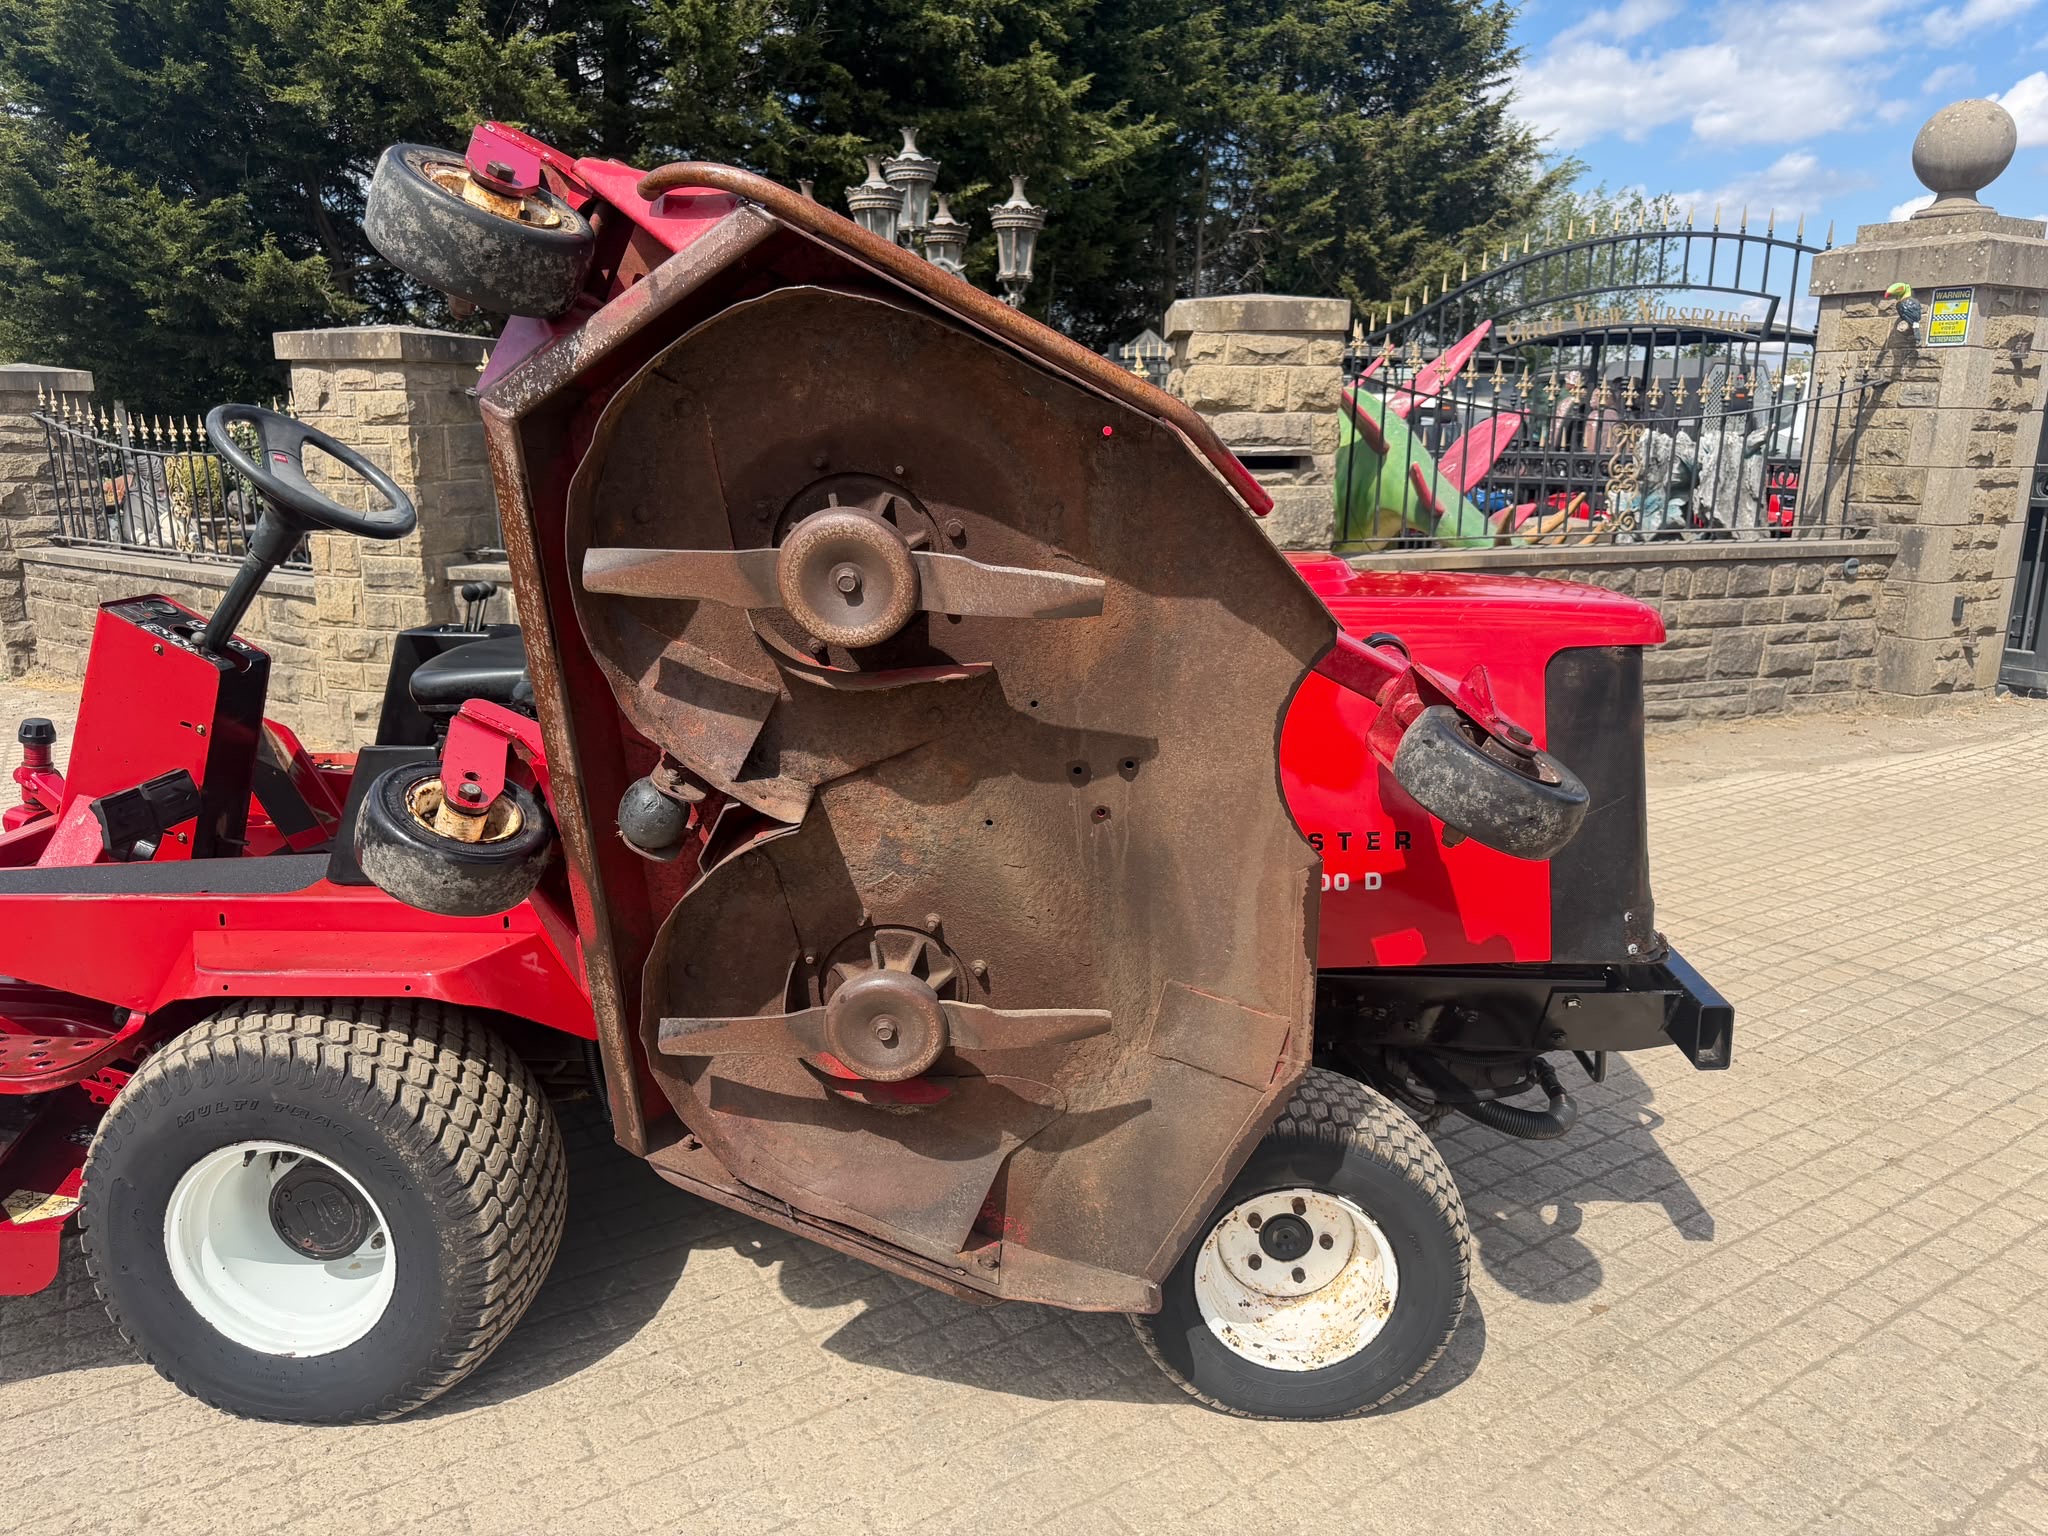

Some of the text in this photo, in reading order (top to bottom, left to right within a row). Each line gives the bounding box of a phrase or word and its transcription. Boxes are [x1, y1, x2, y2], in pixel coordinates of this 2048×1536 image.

[1935, 290, 1971, 300] WARNING
[1574, 302, 1622, 329] VIEW
[1633, 297, 1751, 334] NURSERIES
[1307, 831, 1412, 851] STER
[1365, 872, 1382, 890] D
[177, 1099, 260, 1128] MULTI
[273, 1101, 353, 1137] TRAC
